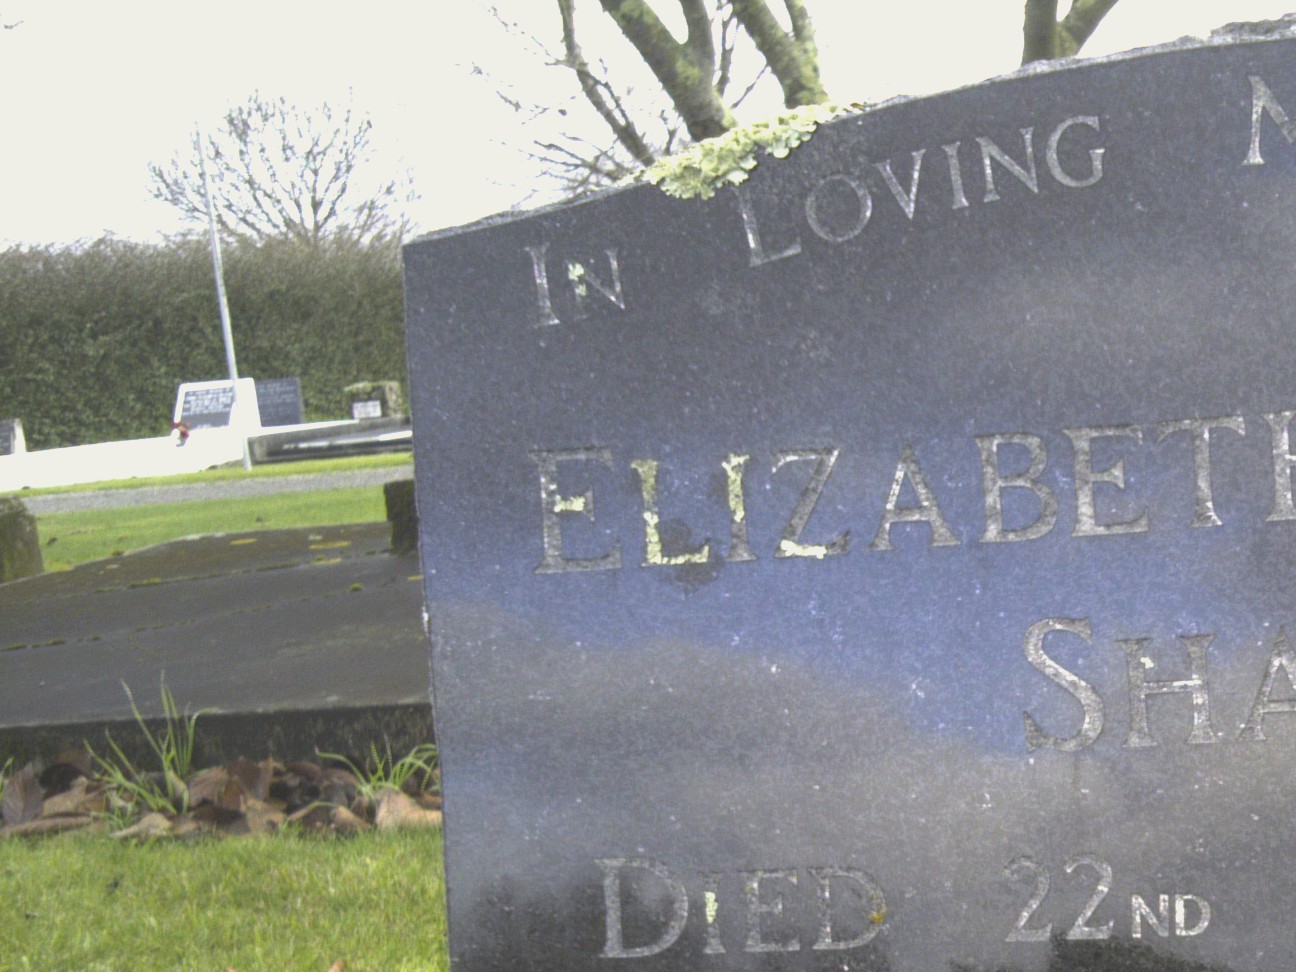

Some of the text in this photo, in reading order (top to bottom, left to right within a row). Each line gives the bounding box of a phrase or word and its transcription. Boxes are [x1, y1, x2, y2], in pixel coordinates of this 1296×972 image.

[524, 242, 626, 328] IN
[737, 114, 1107, 268] LOVING
[594, 856, 888, 960] DIED
